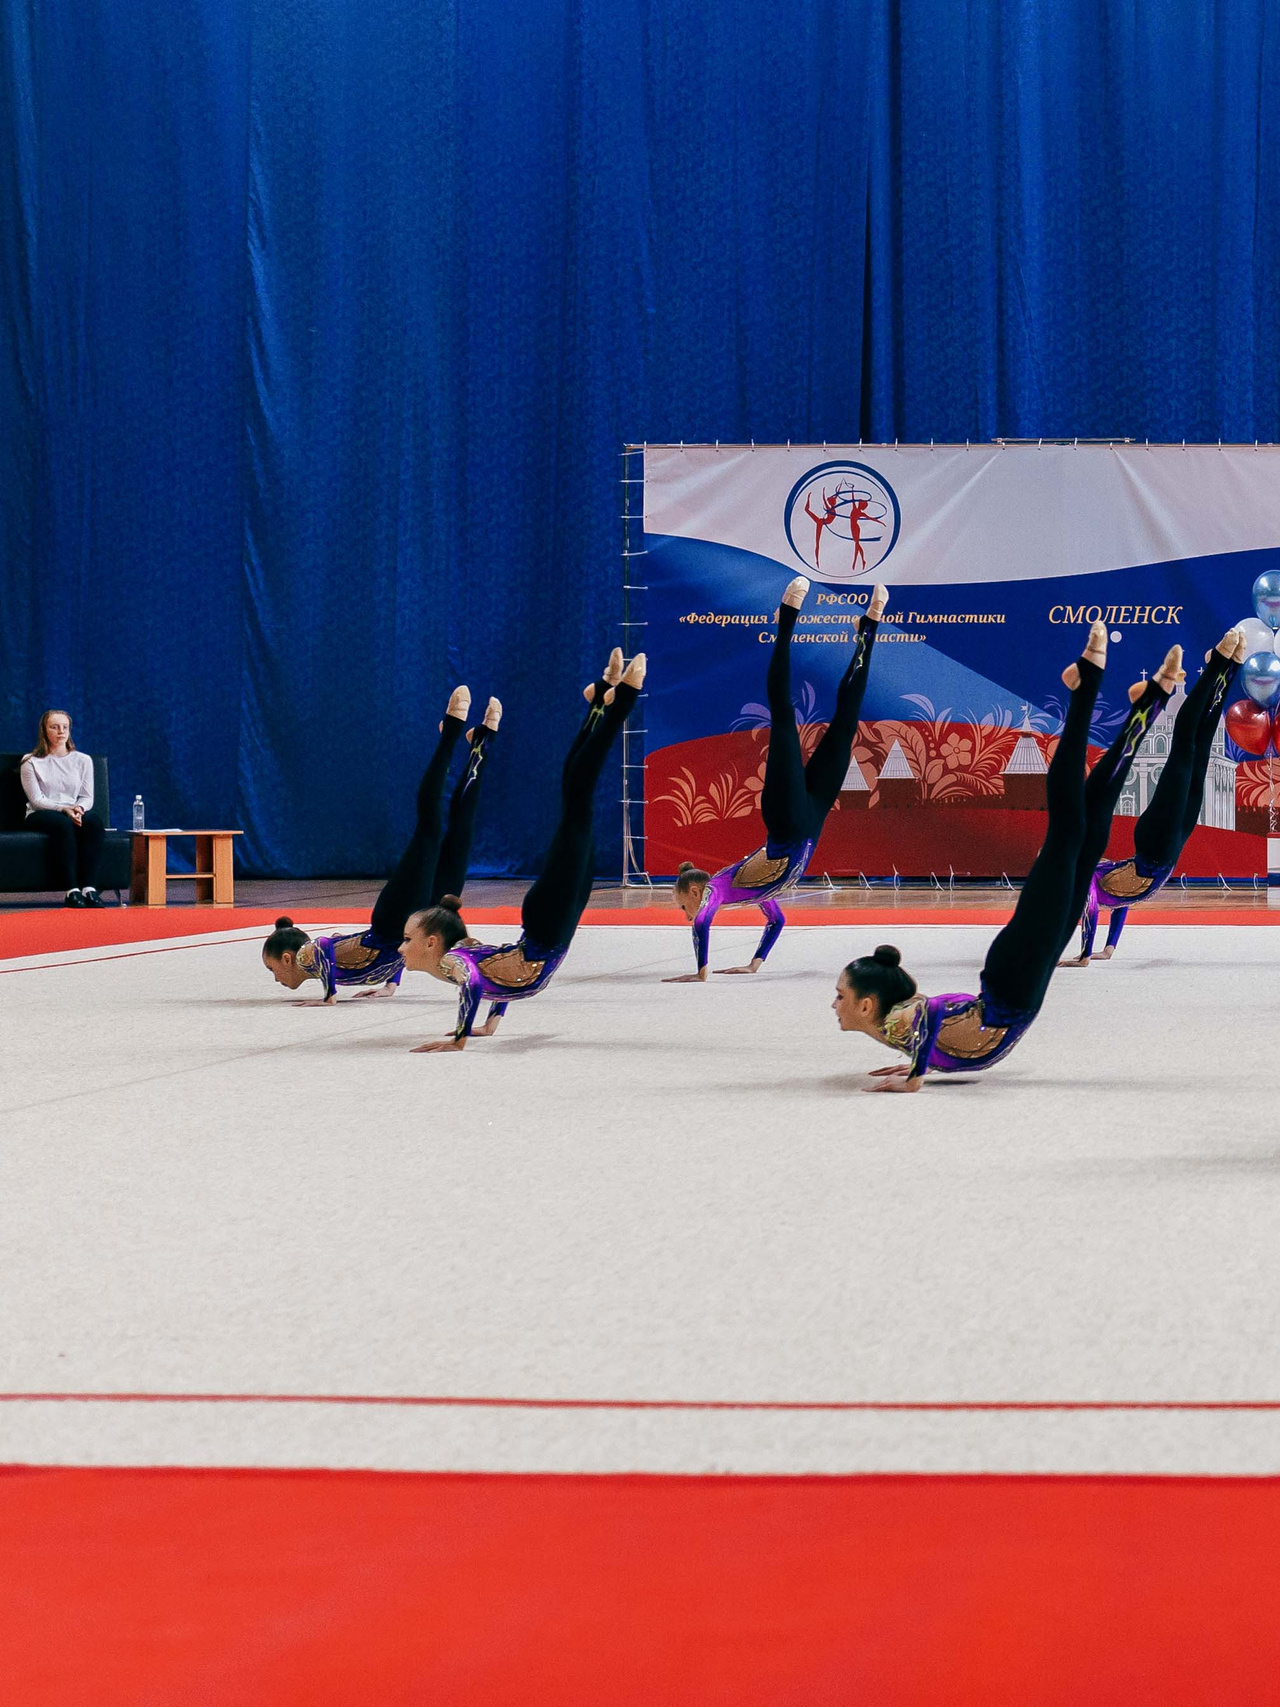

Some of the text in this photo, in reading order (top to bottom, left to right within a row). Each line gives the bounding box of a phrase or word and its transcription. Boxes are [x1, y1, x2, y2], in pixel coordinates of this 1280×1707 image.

[816, 593, 869, 605] РФСОО
[679, 612, 768, 627] «Федерация
[907, 611, 1005, 624] Гимнастики
[1048, 605, 1184, 625] СМОЛЕНСК
[758, 631, 849, 643] Смленской
